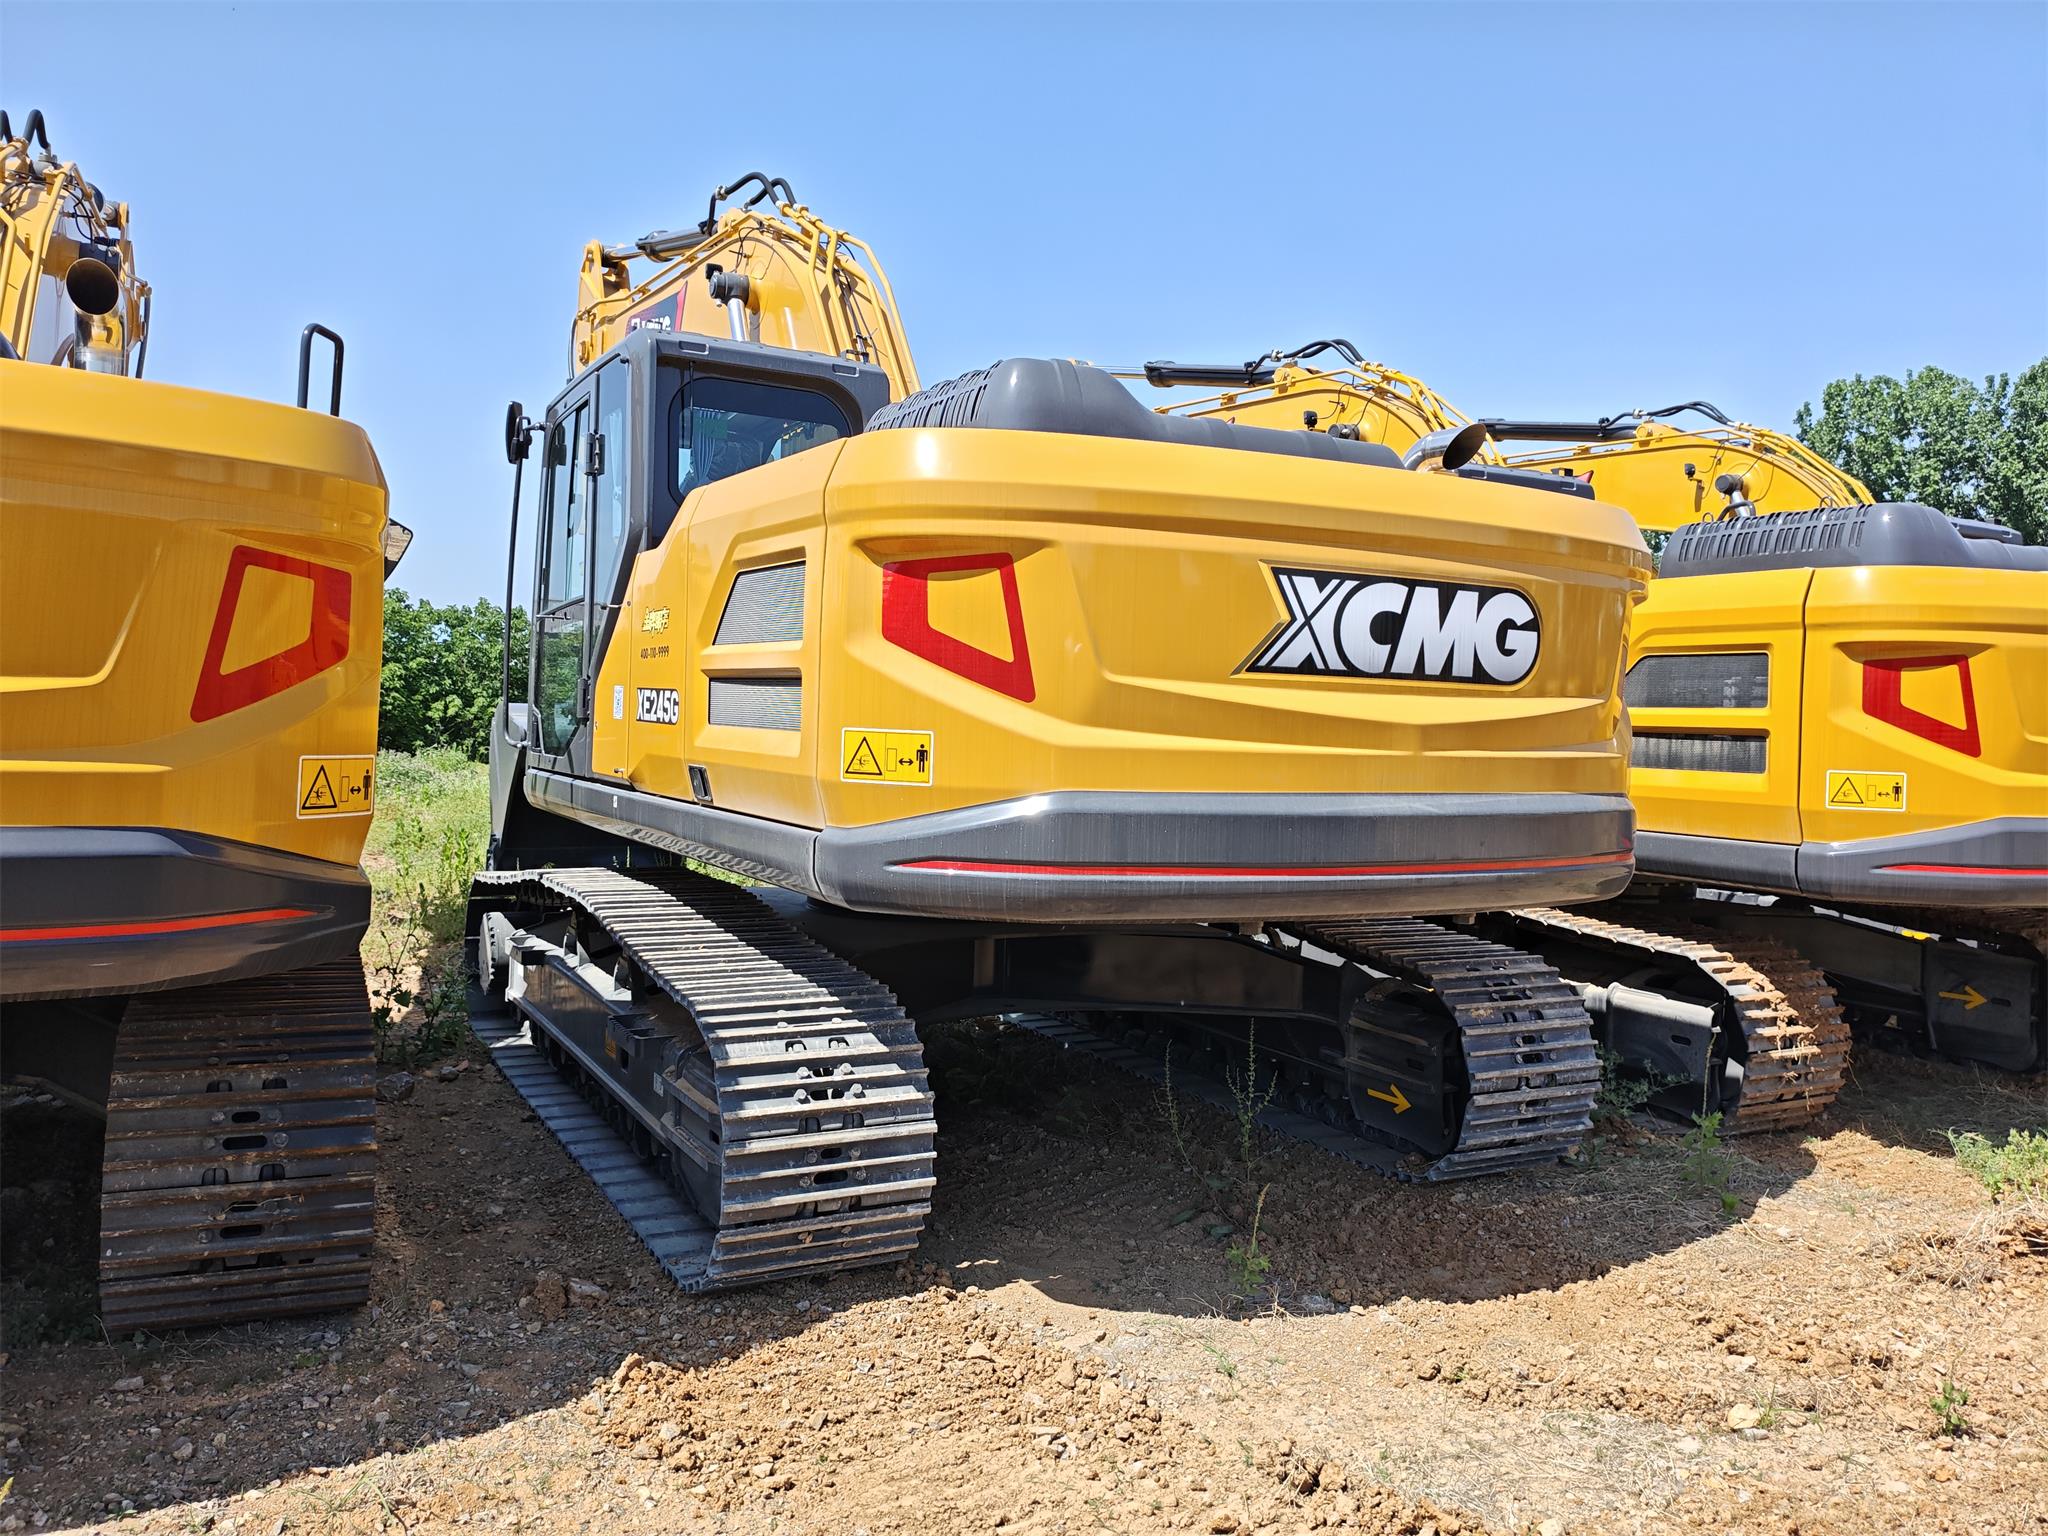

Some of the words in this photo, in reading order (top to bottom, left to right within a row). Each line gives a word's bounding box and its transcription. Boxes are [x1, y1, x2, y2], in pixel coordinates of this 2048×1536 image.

[1256, 574, 1538, 682] XCMG
[640, 645, 670, 659] 400-110-9999
[636, 688, 679, 723] XE245G
